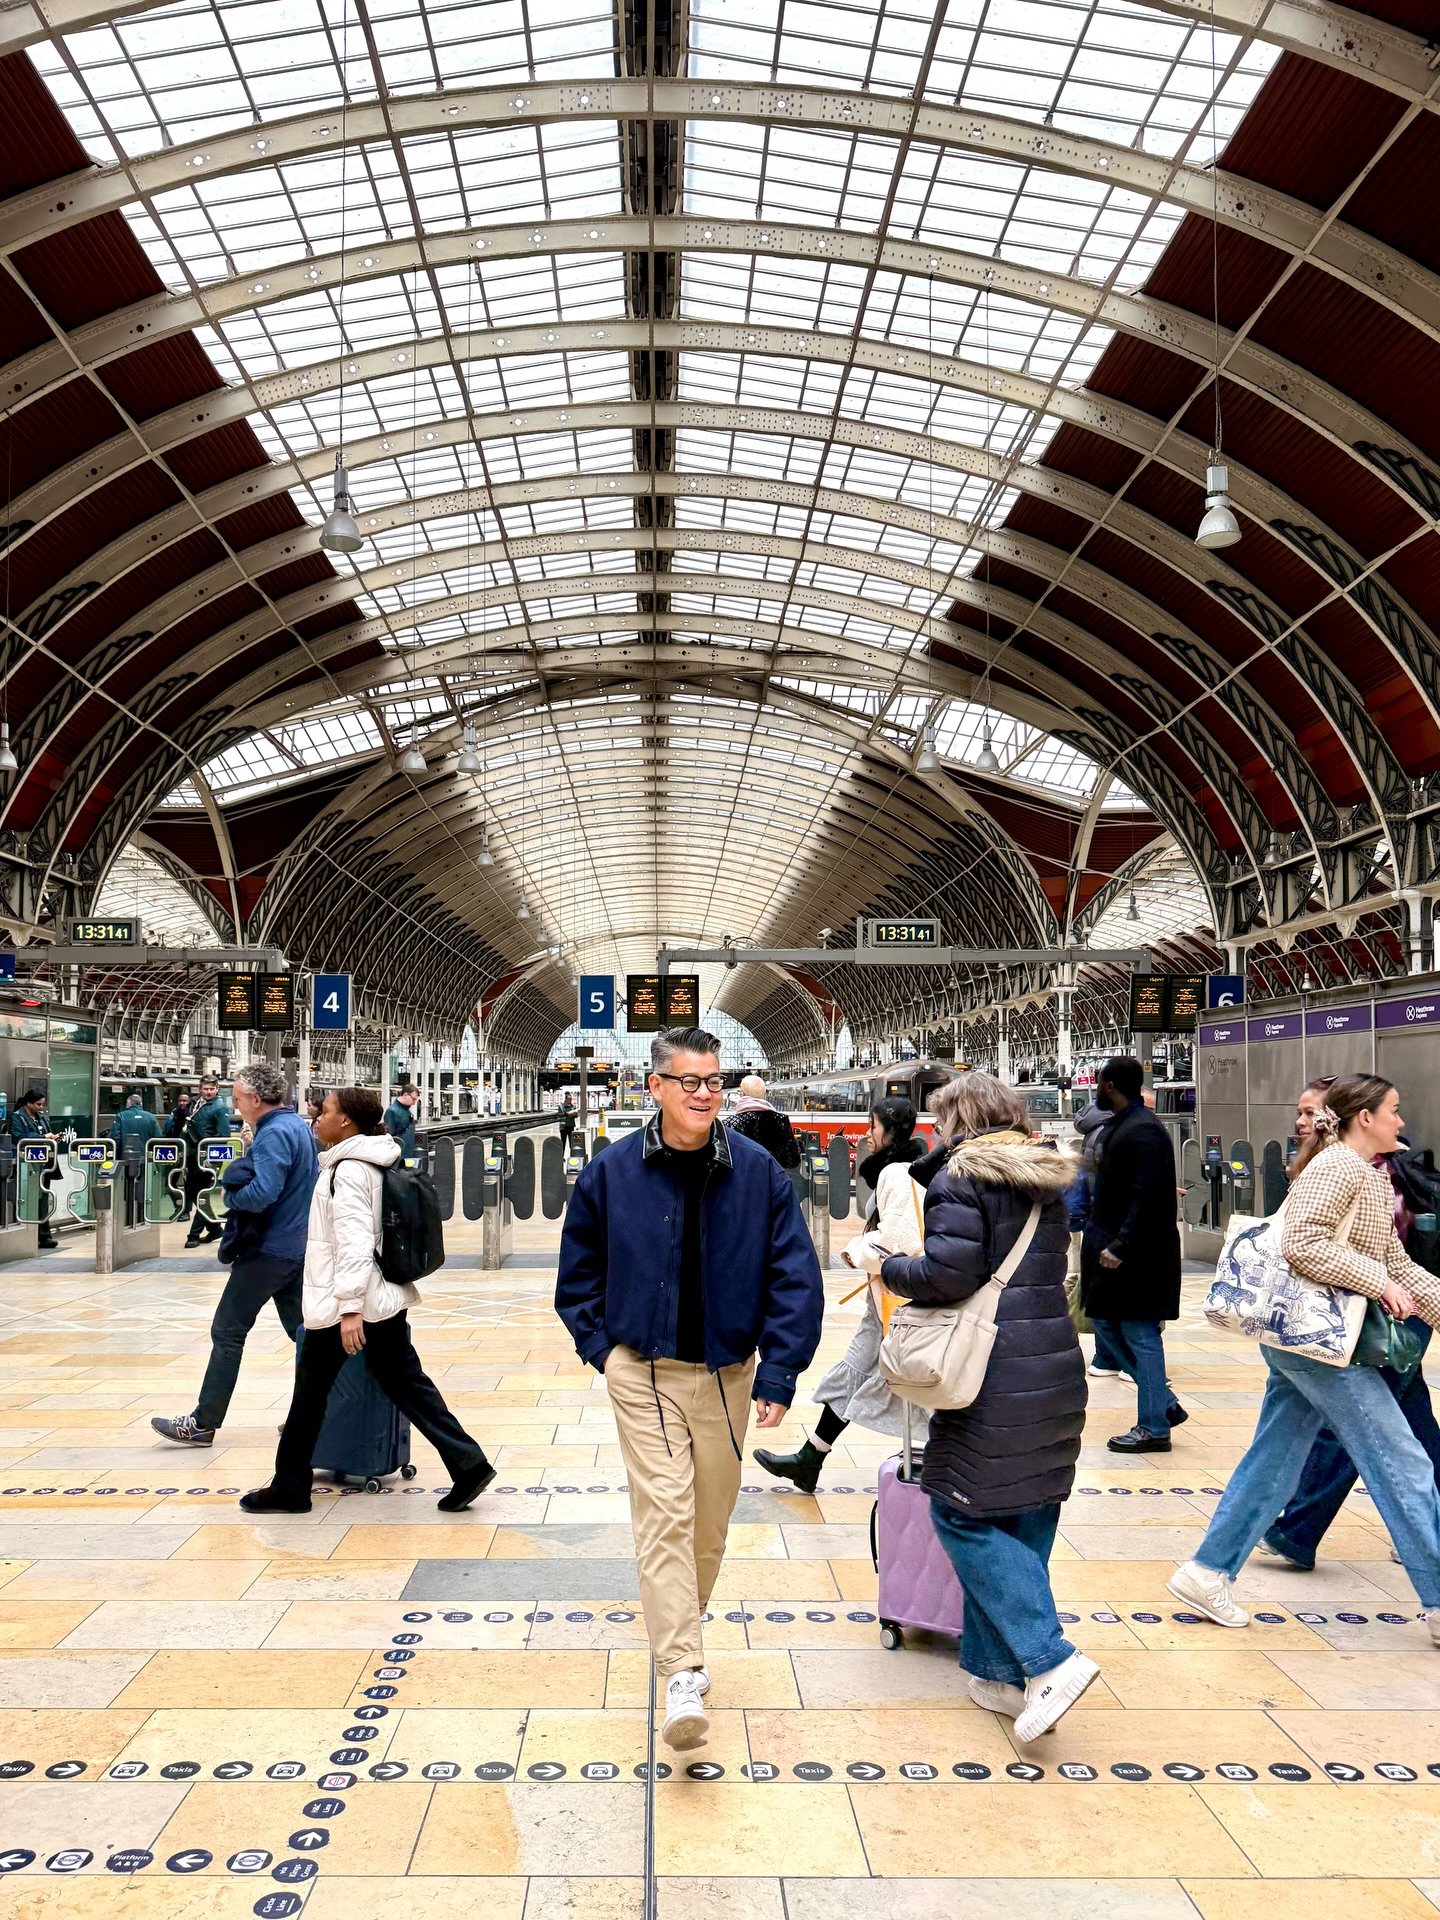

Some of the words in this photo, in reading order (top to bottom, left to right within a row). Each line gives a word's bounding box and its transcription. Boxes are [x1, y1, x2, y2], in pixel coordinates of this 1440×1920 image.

[322, 991, 340, 1013] 4
[590, 992, 605, 1013] 5
[1218, 992, 1235, 1008] 6
[1040, 1685, 1053, 1699] FILA
[263, 1897, 276, 1913] Circle
[276, 1899, 288, 1911] Line
